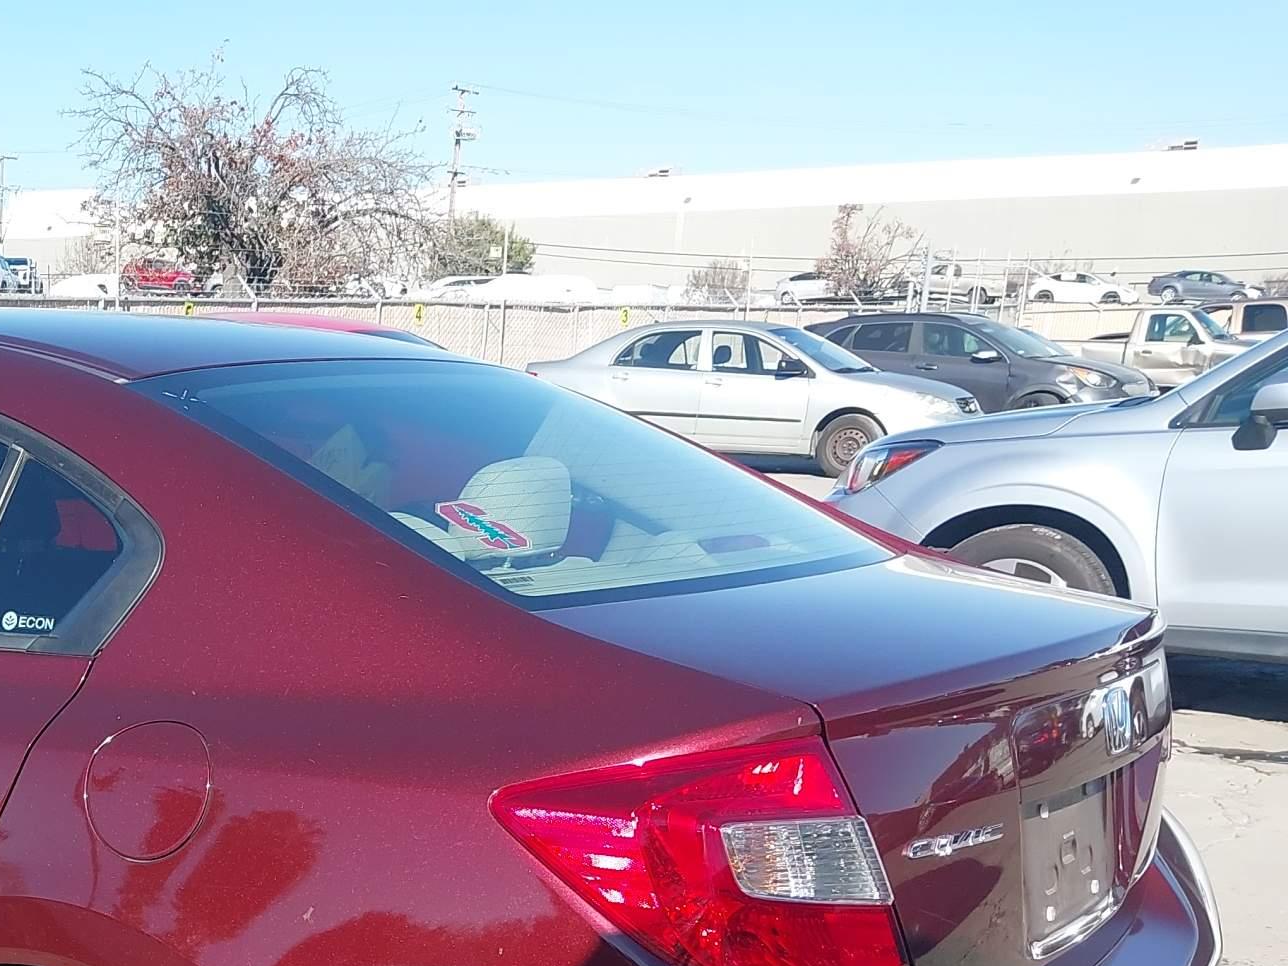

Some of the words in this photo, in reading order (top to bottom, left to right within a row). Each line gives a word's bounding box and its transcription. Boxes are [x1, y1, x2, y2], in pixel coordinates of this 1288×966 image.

[415, 304, 422, 322] 4
[622, 309, 628, 324] 3
[18, 615, 55, 630] ECON
[902, 823, 1004, 859] CIVIC
